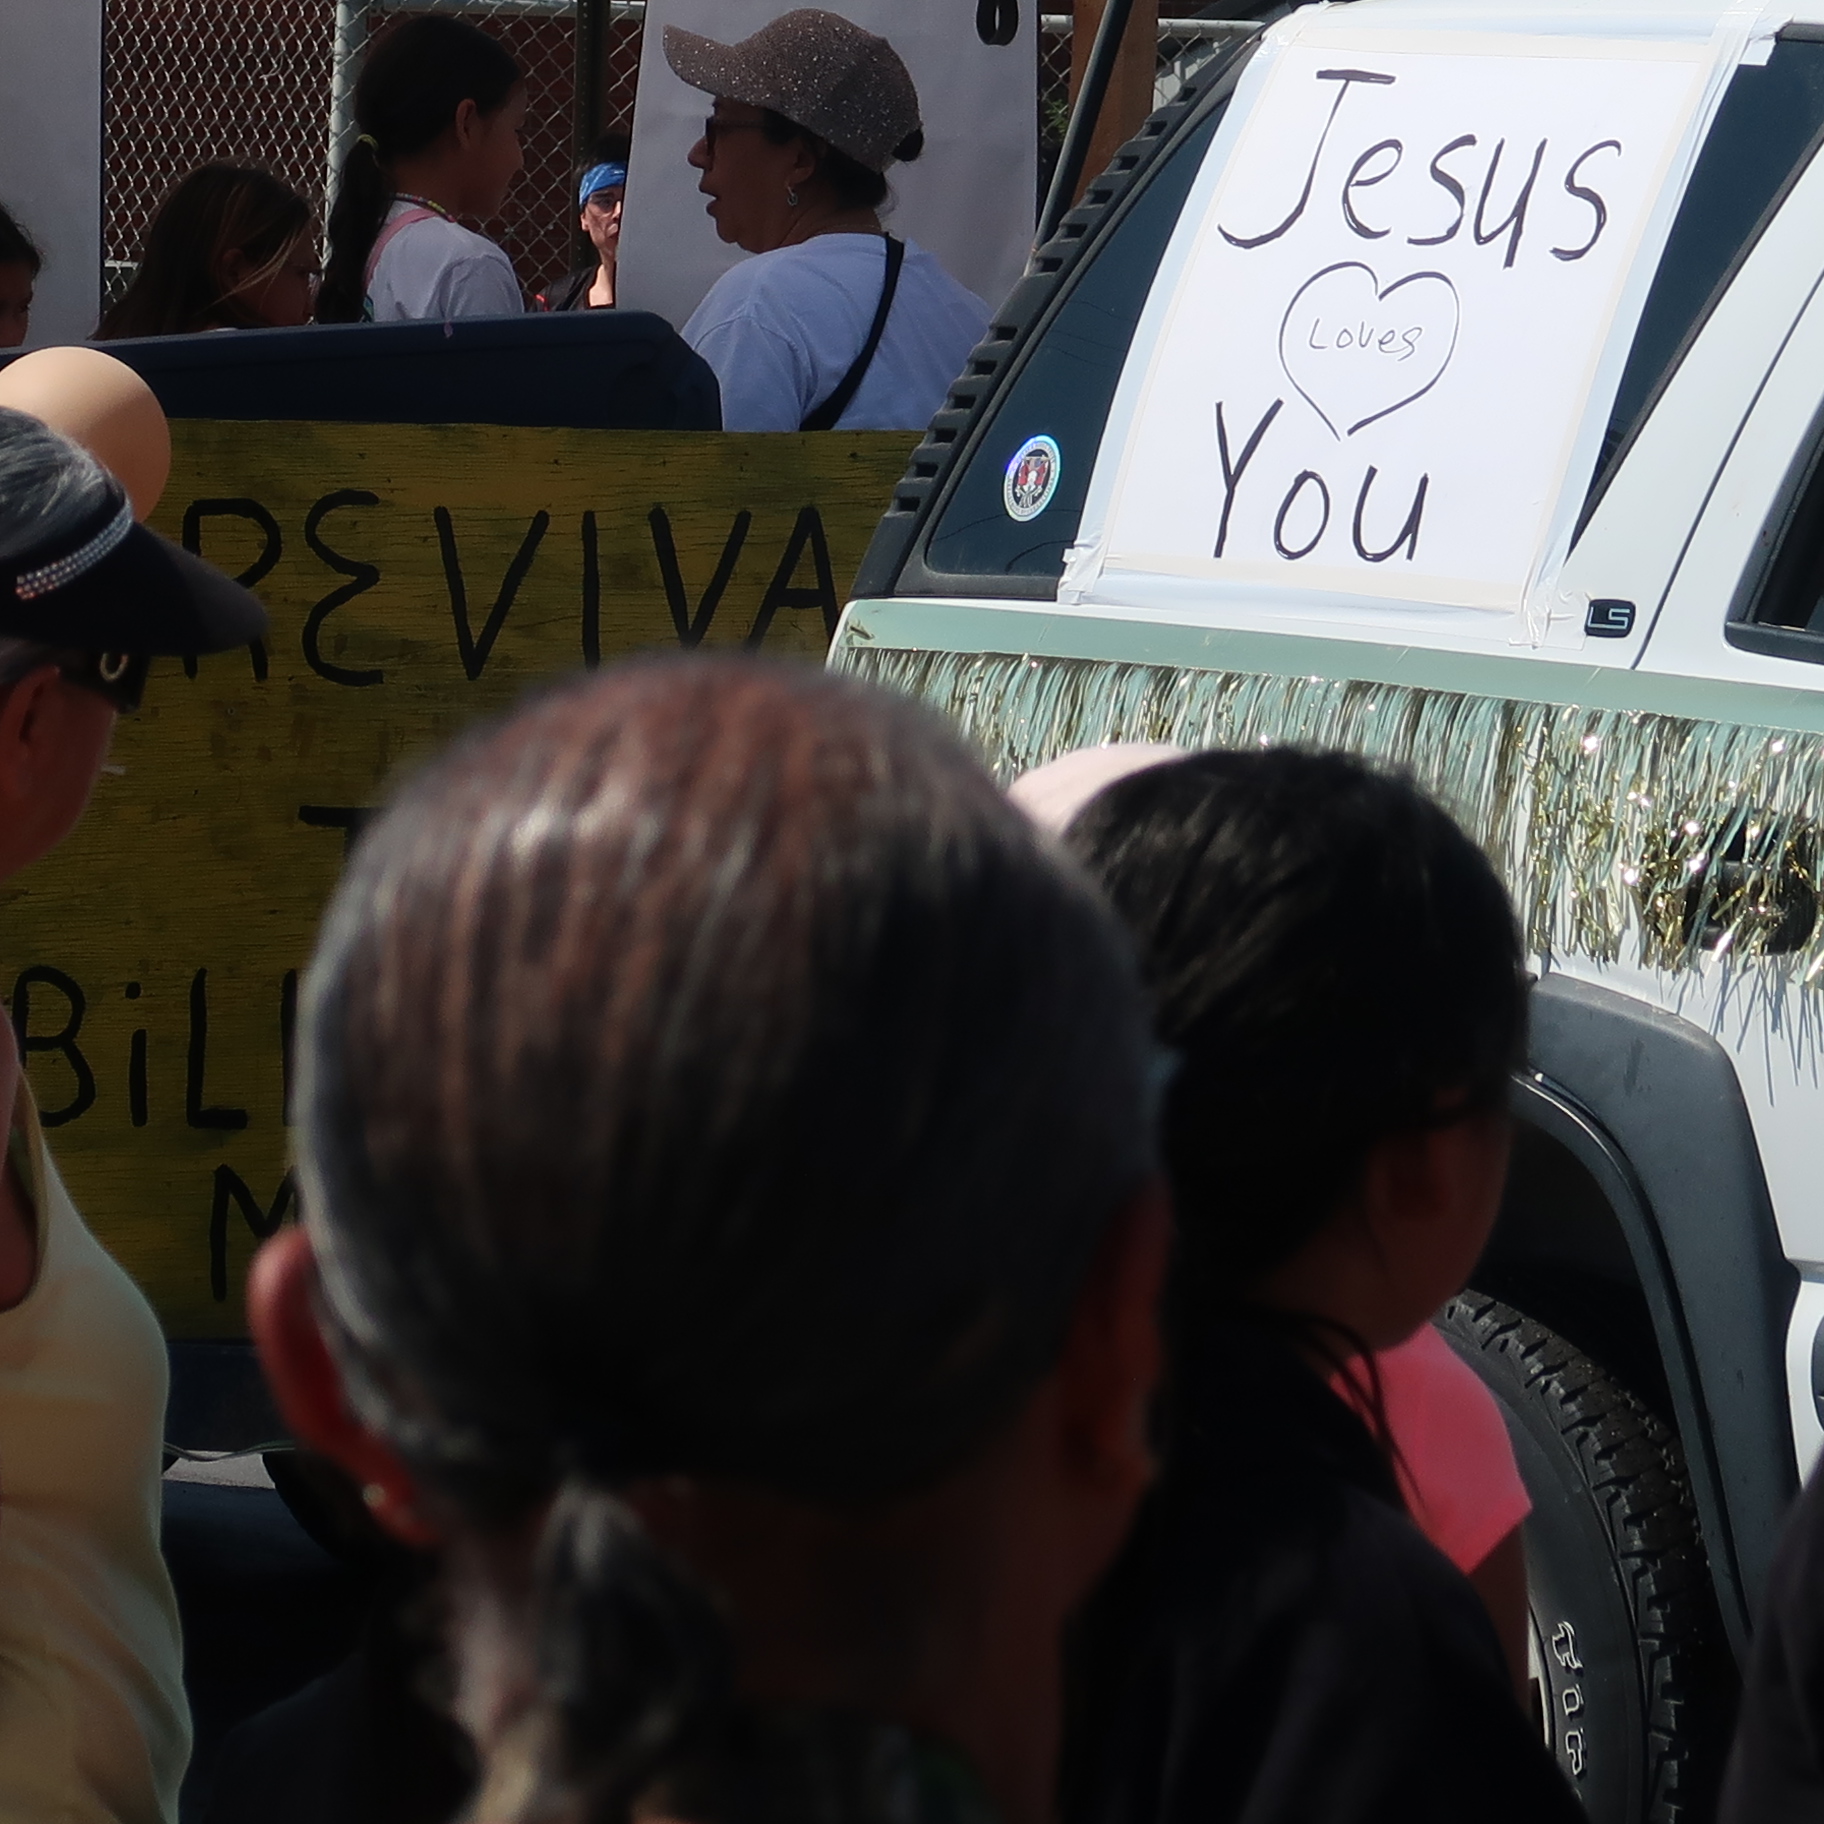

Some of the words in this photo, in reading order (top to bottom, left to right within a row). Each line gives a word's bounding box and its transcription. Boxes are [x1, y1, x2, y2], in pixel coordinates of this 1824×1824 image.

[1217, 69, 1622, 269] Jesus
[1214, 397, 1430, 563] You
[1587, 606, 1631, 630] LS
